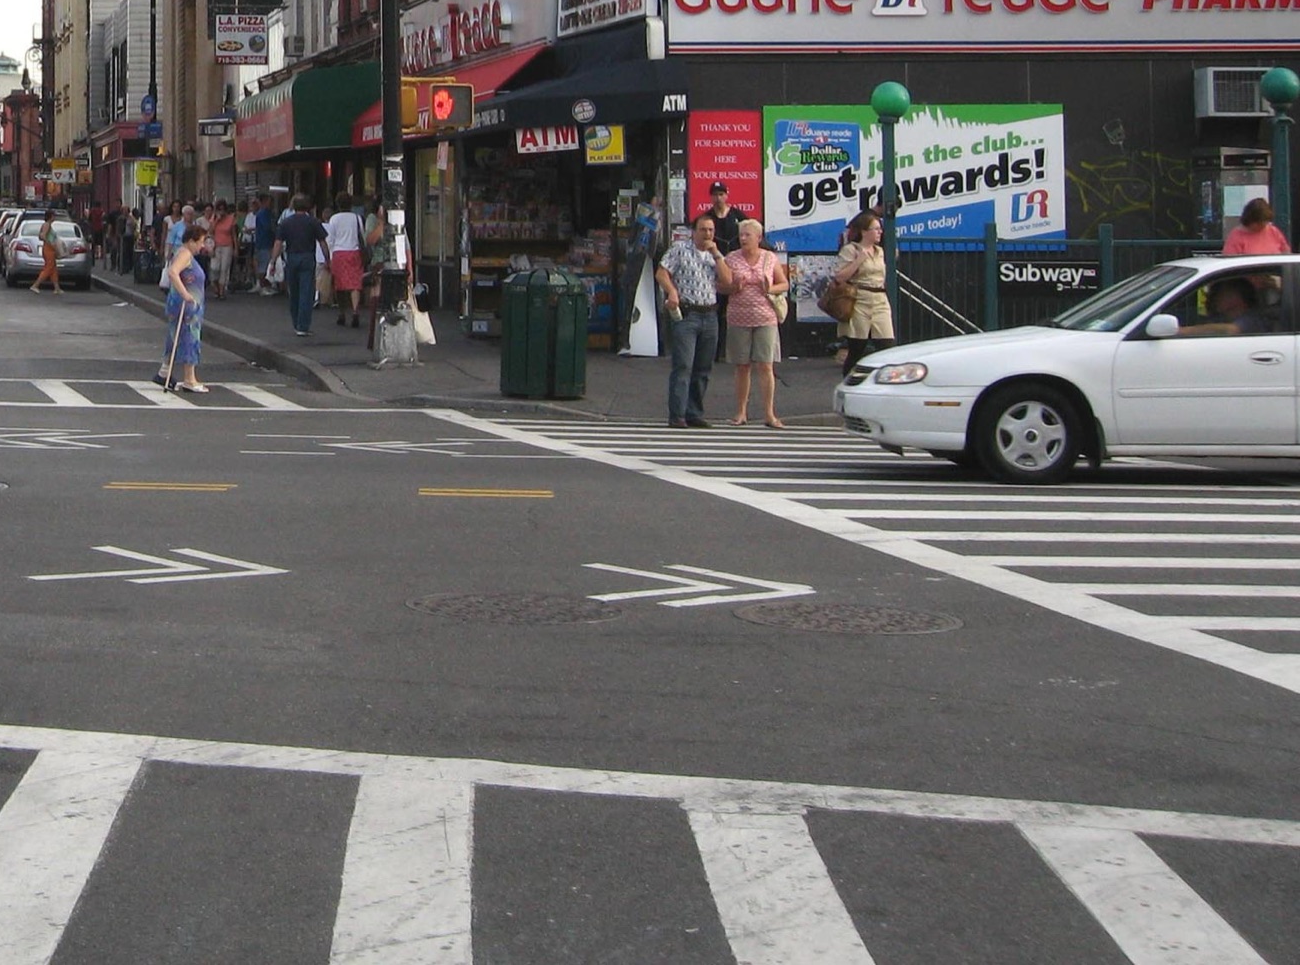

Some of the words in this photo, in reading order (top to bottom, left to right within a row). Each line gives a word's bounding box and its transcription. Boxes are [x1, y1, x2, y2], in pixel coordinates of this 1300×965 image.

[238, 16, 266, 25] PIZZA
[662, 94, 688, 112] ATM
[700, 123, 731, 132] THANK
[732, 123, 751, 132] YOU
[520, 126, 576, 148] ATM
[694, 139, 712, 148] FOR
[713, 139, 756, 148] SHOPPING
[922, 144, 963, 164] the
[970, 131, 1045, 156] club...
[810, 145, 842, 155] Dollar
[714, 155, 737, 164] HERE
[801, 150, 849, 165] Rewards
[812, 162, 838, 172] Club
[693, 172, 718, 180] YOUR
[719, 172, 758, 180] BUSINESS
[787, 165, 857, 217] get
[697, 203, 755, 211] APPATED
[910, 221, 925, 235] up
[927, 213, 963, 229] today!
[1010, 223, 1031, 232] duane
[999, 263, 1083, 286] Subway
